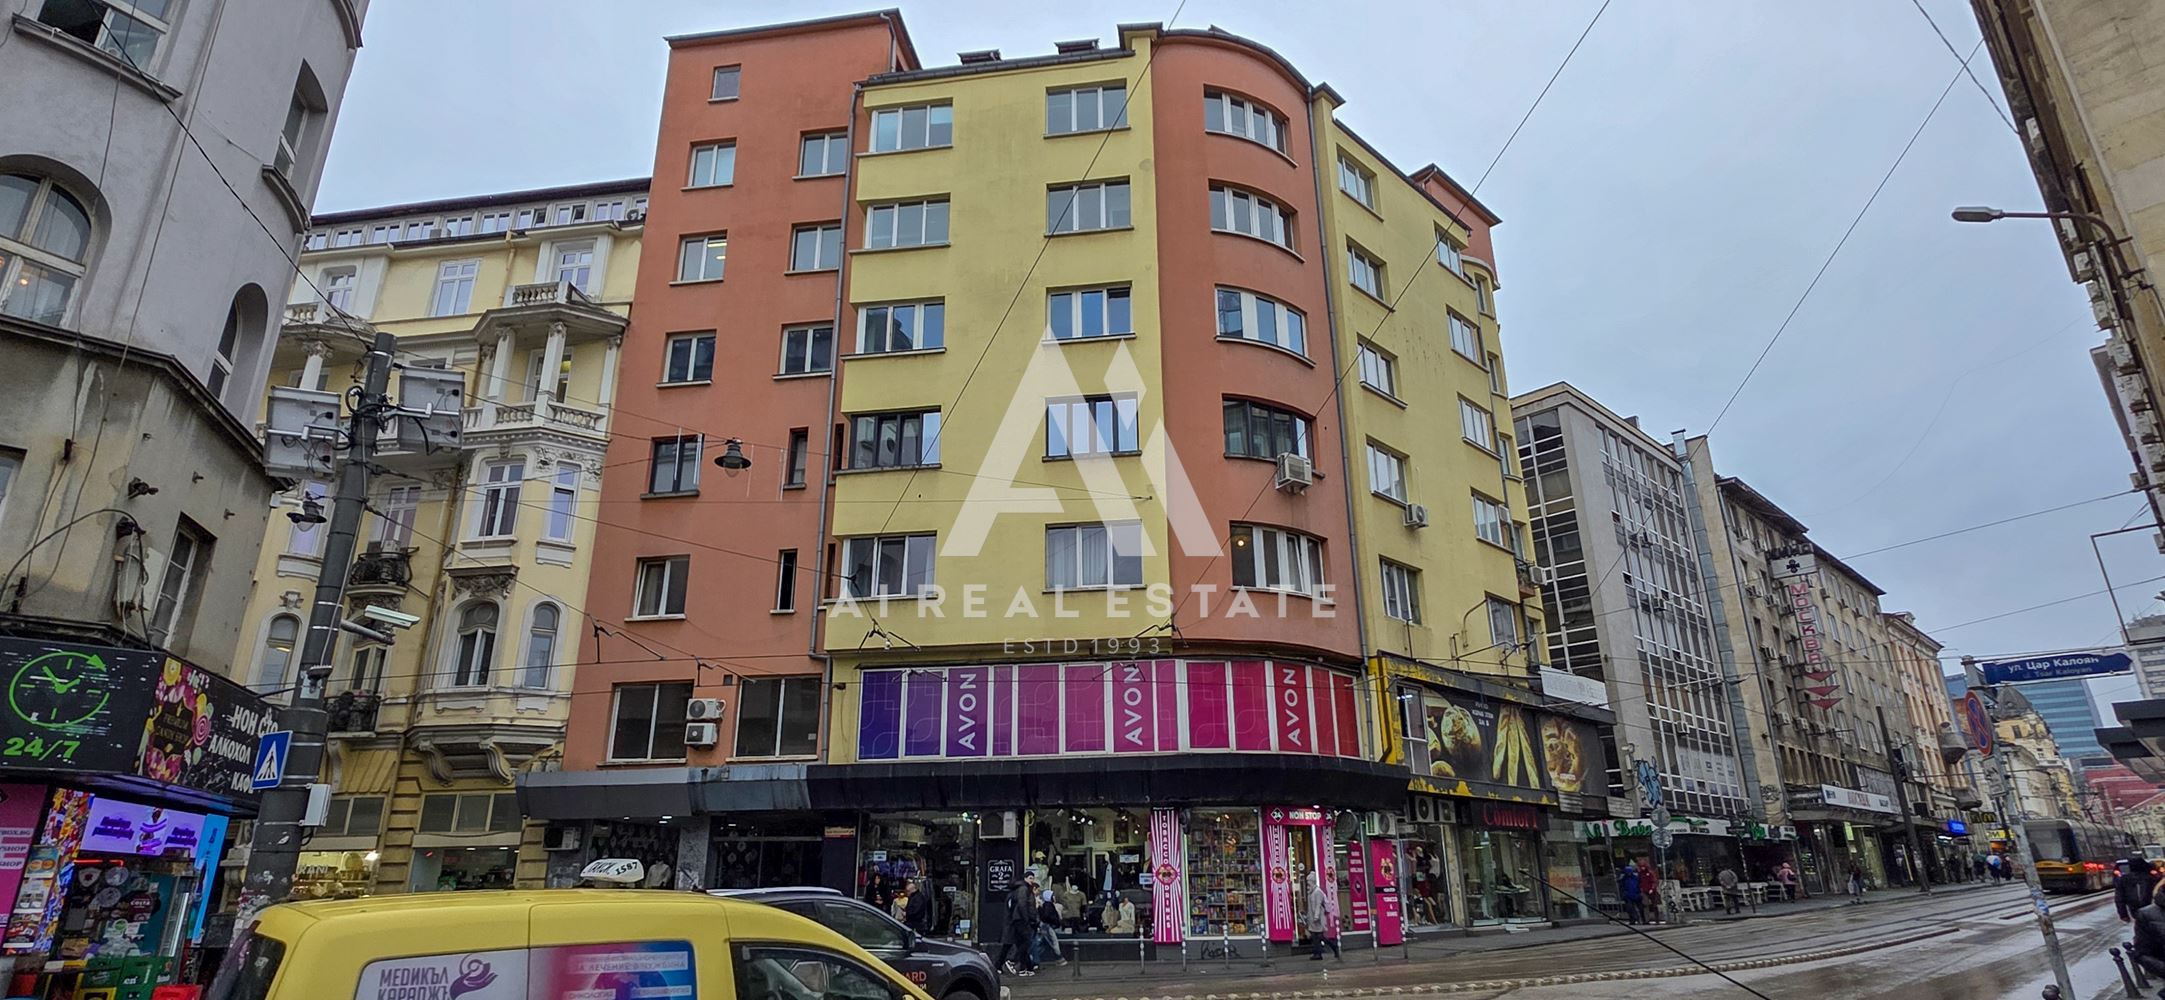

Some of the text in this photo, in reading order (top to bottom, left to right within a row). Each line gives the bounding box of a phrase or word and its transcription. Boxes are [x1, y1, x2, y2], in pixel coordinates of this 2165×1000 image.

[1789, 583, 1822, 664] МОСКВА
[2026, 661, 2050, 670] Цар
[2053, 656, 2099, 668] Калоян
[231, 705, 259, 736] НОН
[958, 673, 976, 751] AVON
[1123, 666, 1143, 746] AVON
[1282, 667, 1302, 747] AVON
[3, 737, 80, 761] 24/7
[208, 735, 252, 765] АЛКОХОЛ
[1289, 811, 1304, 819] NON
[1305, 811, 1322, 821] STOP
[1161, 815, 1169, 864] TOBACCO
[615, 861, 638, 875] 1587
[989, 865, 1012, 873] GRAFA
[998, 872, 1004, 880] 2
